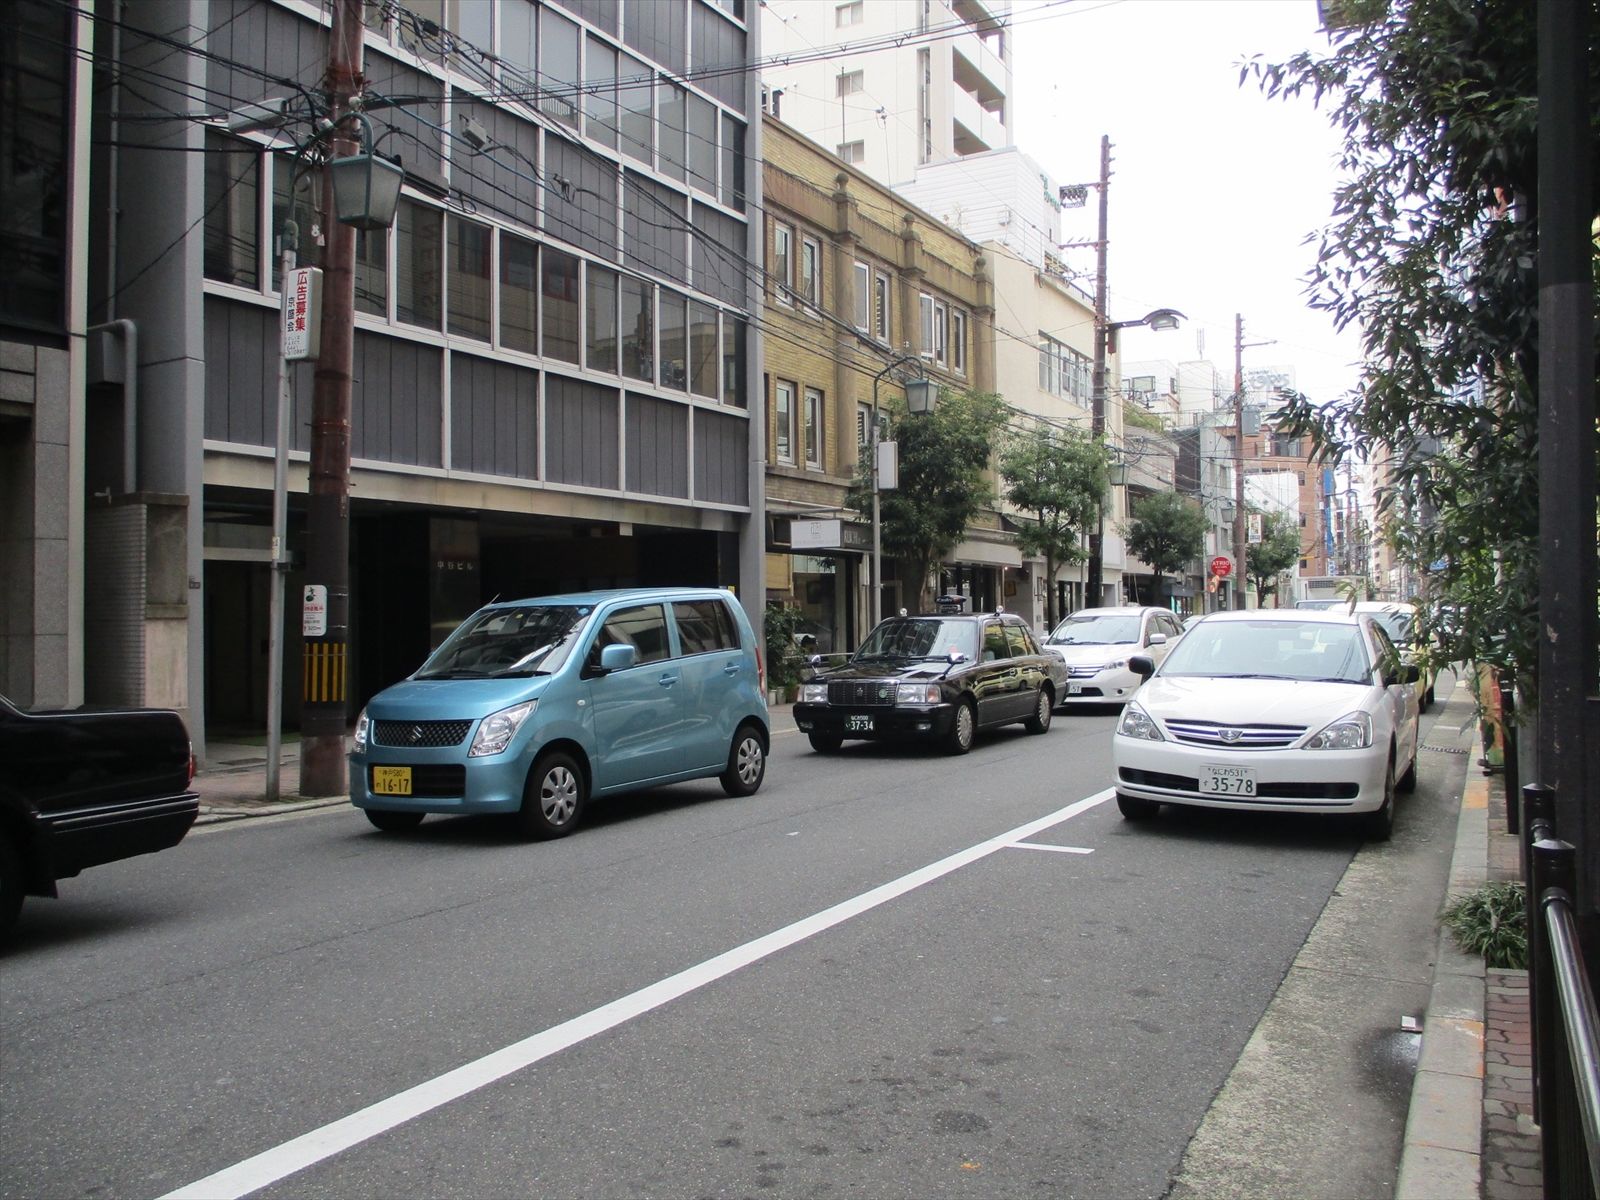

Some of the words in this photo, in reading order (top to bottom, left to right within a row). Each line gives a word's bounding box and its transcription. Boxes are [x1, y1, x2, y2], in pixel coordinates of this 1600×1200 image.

[295, 270, 308, 332] 広告募集
[850, 720, 874, 731] 37-34
[383, 778, 409, 792] 16-17
[1211, 776, 1253, 793] 35-78
